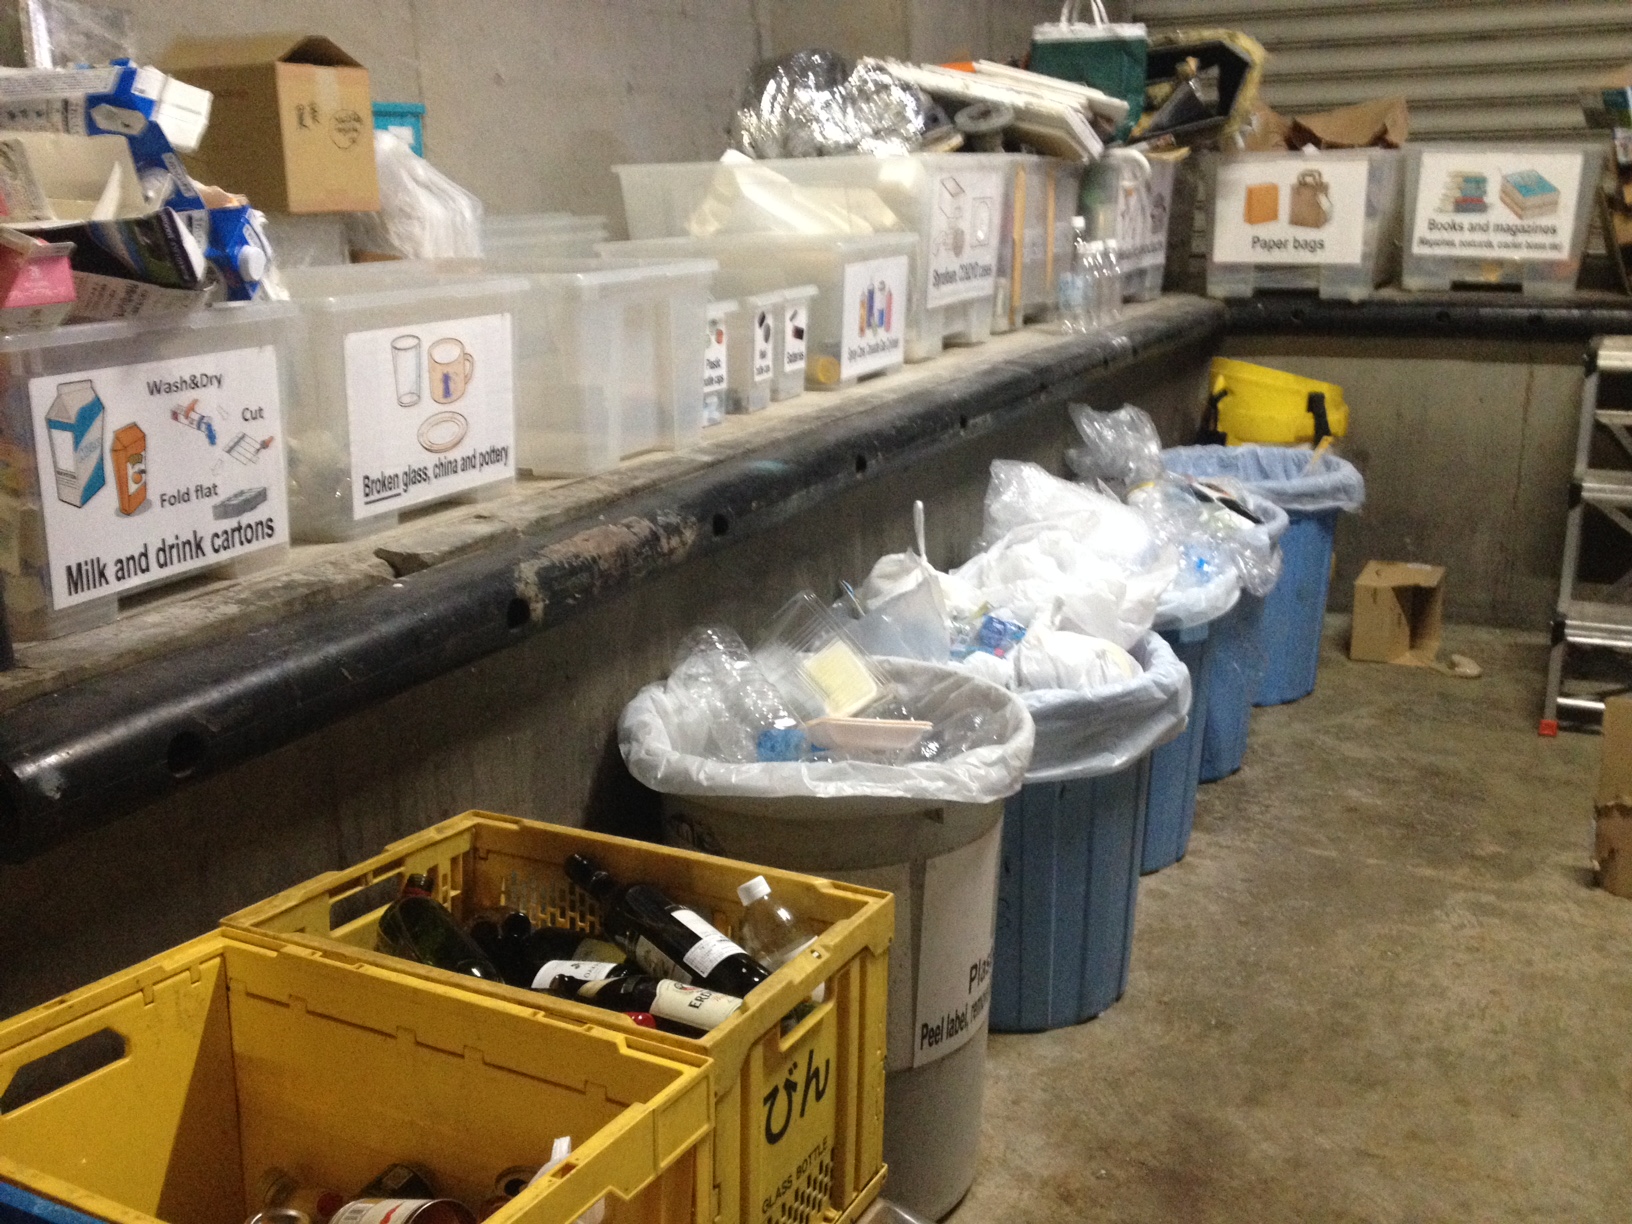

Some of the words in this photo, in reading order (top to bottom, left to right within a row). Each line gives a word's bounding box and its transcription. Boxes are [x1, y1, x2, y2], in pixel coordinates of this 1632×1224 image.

[1427, 218, 1464, 232] Books
[1467, 220, 1490, 233] and
[1492, 221, 1557, 236] magazines
[1251, 235, 1289, 252] Paper
[1292, 236, 1325, 252] bags
[147, 372, 222, 396] Wash&Dry
[242, 406, 265, 422] Cut
[362, 471, 400, 498] Broken
[402, 464, 431, 493] glass,
[433, 455, 458, 478] china
[460, 448, 477, 470] and
[479, 445, 509, 471] pottery
[160, 486, 191, 508] Fold
[194, 483, 219, 499] flat
[65, 557, 109, 596] Milk
[115, 543, 150, 582] and
[156, 530, 206, 569] drink
[211, 517, 275, 554] cartons
[968, 957, 993, 995] Plas
[688, 983, 717, 1009] ERD
[920, 1015, 945, 1051] Peel
[762, 1174, 793, 1214] GLASS
[796, 1135, 828, 1181] BOTTLE
